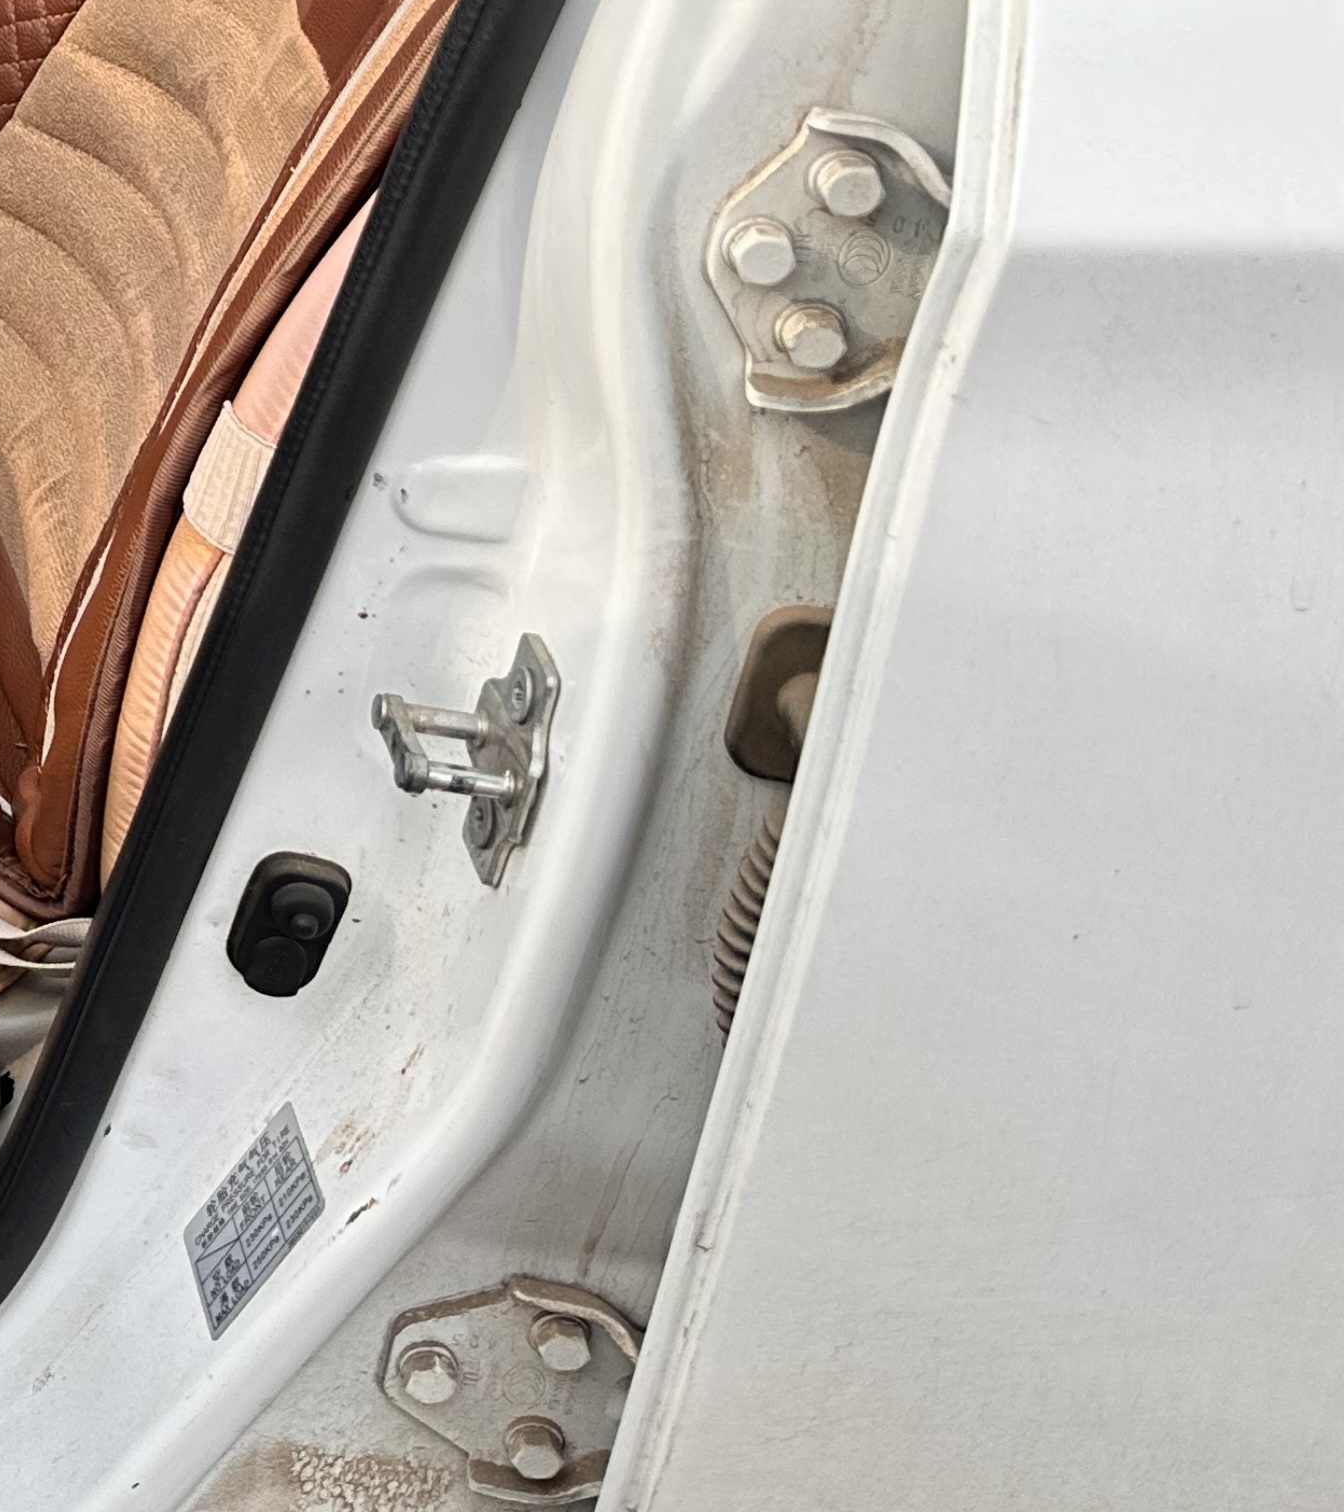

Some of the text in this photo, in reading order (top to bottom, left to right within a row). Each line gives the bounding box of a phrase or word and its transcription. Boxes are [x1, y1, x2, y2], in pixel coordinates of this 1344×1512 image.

[194, 1214, 219, 1246] CHARGE
[221, 1167, 255, 1212] PRESSURE
[272, 1124, 290, 1148] TIRE
